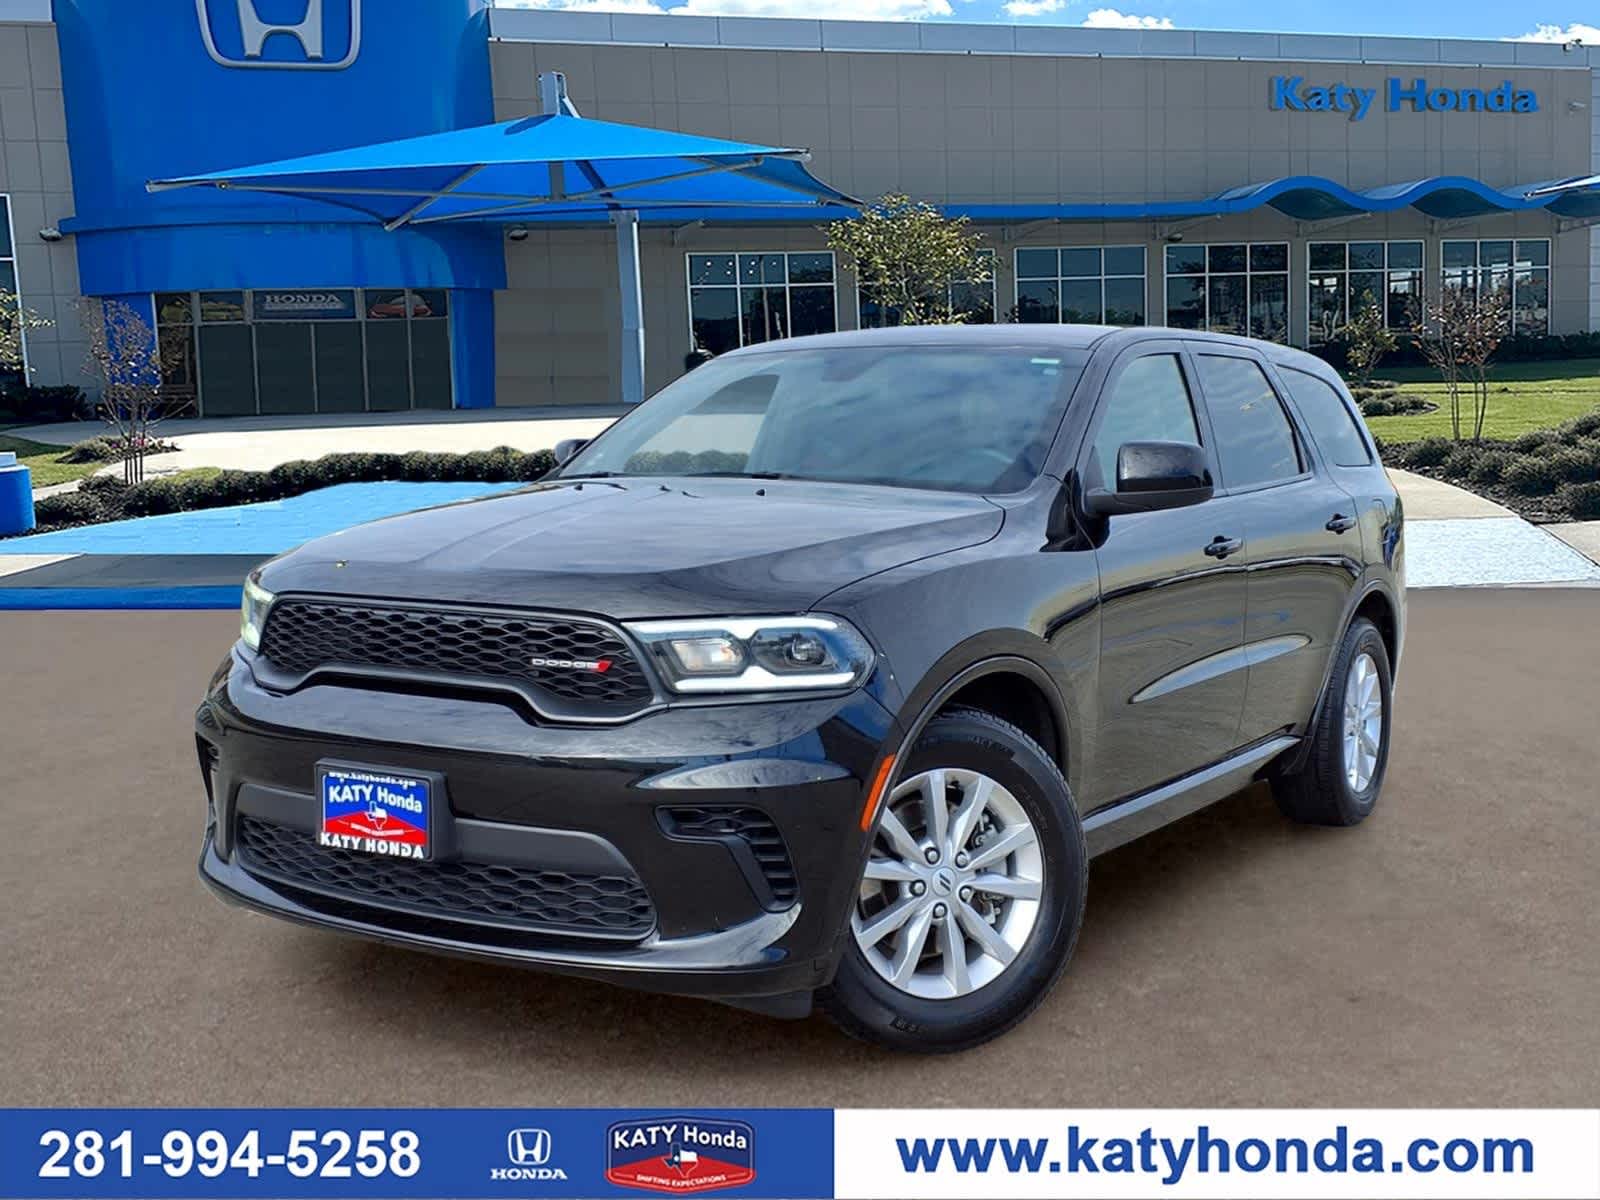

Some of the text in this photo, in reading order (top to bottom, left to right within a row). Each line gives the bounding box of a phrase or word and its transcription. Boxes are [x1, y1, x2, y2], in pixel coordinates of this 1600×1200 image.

[1269, 76, 1539, 121] Katy Honda
[265, 294, 341, 303] HONDA
[532, 658, 599, 669] DODGE
[328, 784, 422, 813] KATY Honda
[320, 831, 424, 858] KATY HONDA
